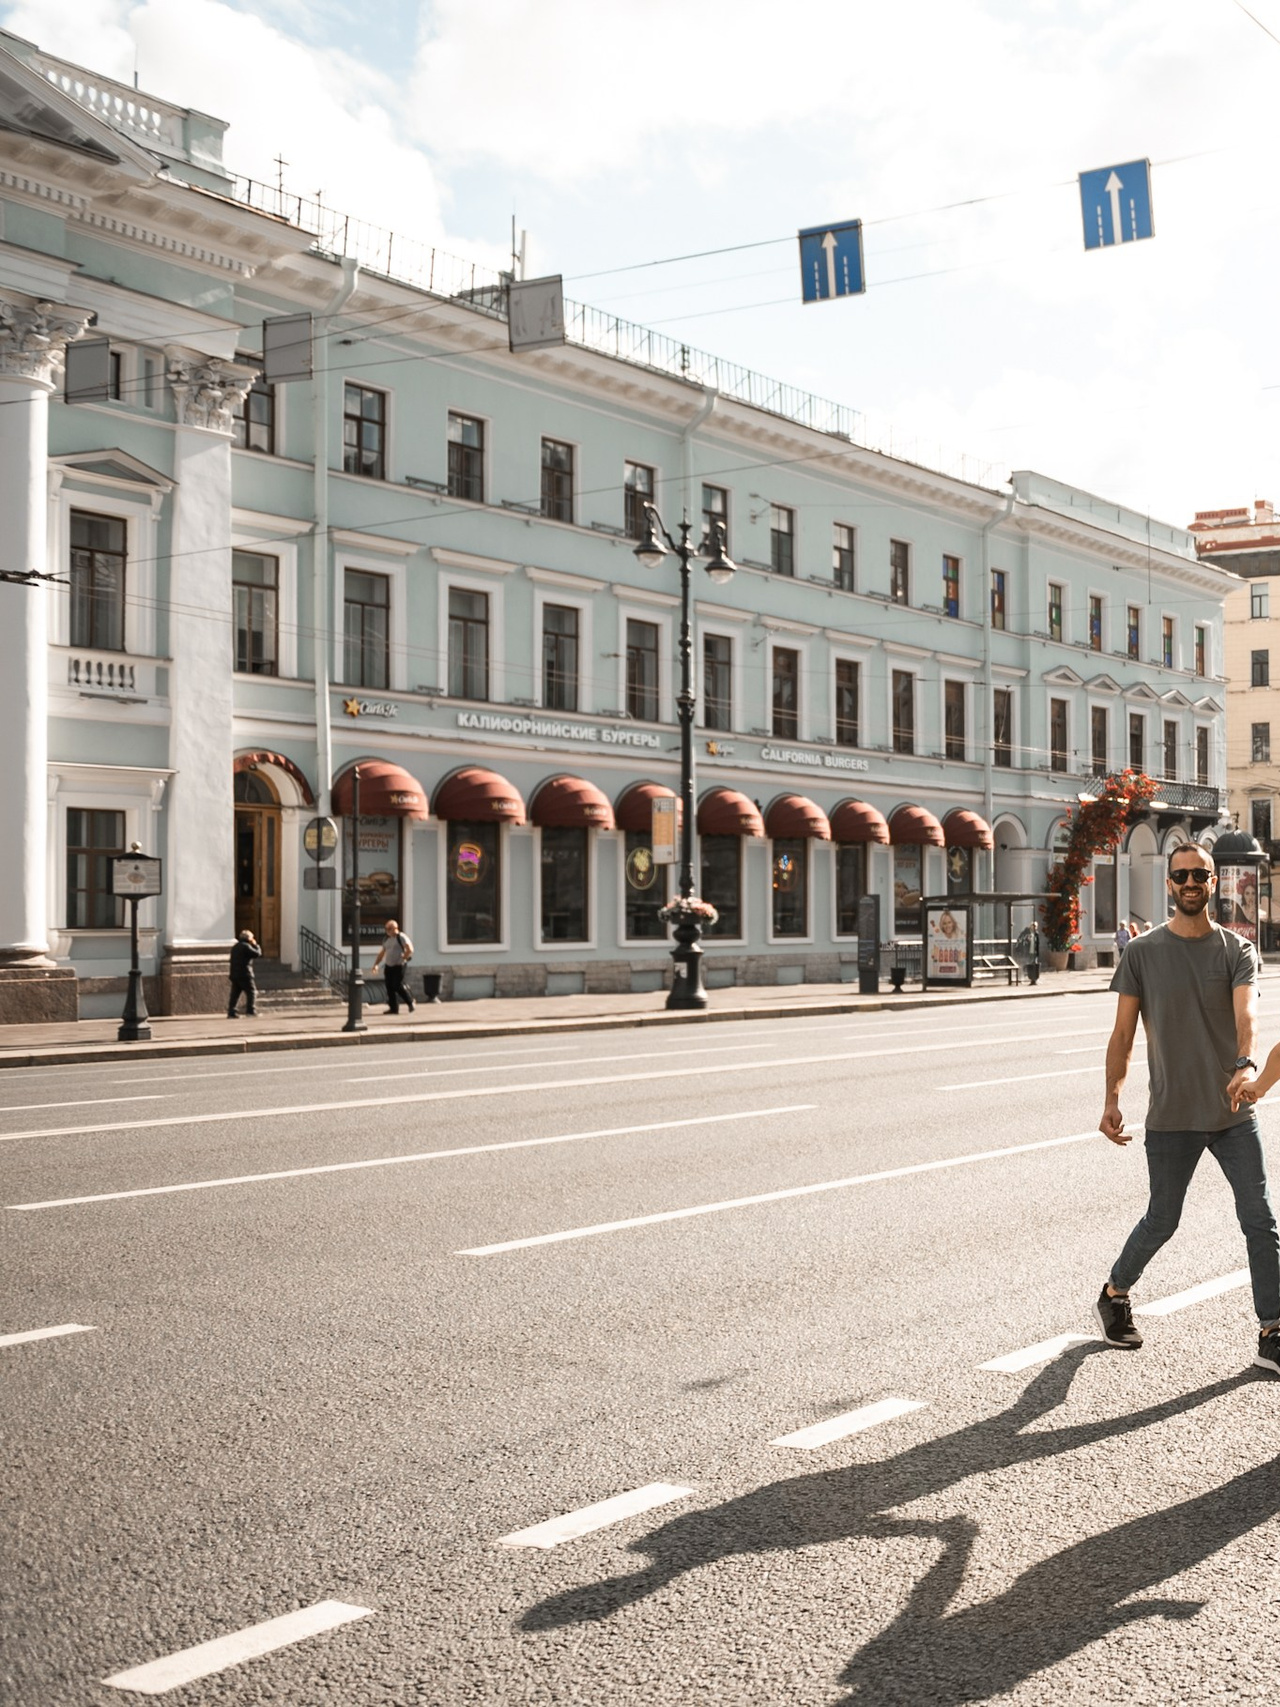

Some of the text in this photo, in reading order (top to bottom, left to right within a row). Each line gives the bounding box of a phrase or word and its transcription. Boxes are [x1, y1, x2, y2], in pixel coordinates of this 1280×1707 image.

[457, 713, 661, 748] КАЛИФОРНИЙСКИЕ БУРГЕРЫ
[761, 748, 869, 771] CALIFORNIA BURGERS
